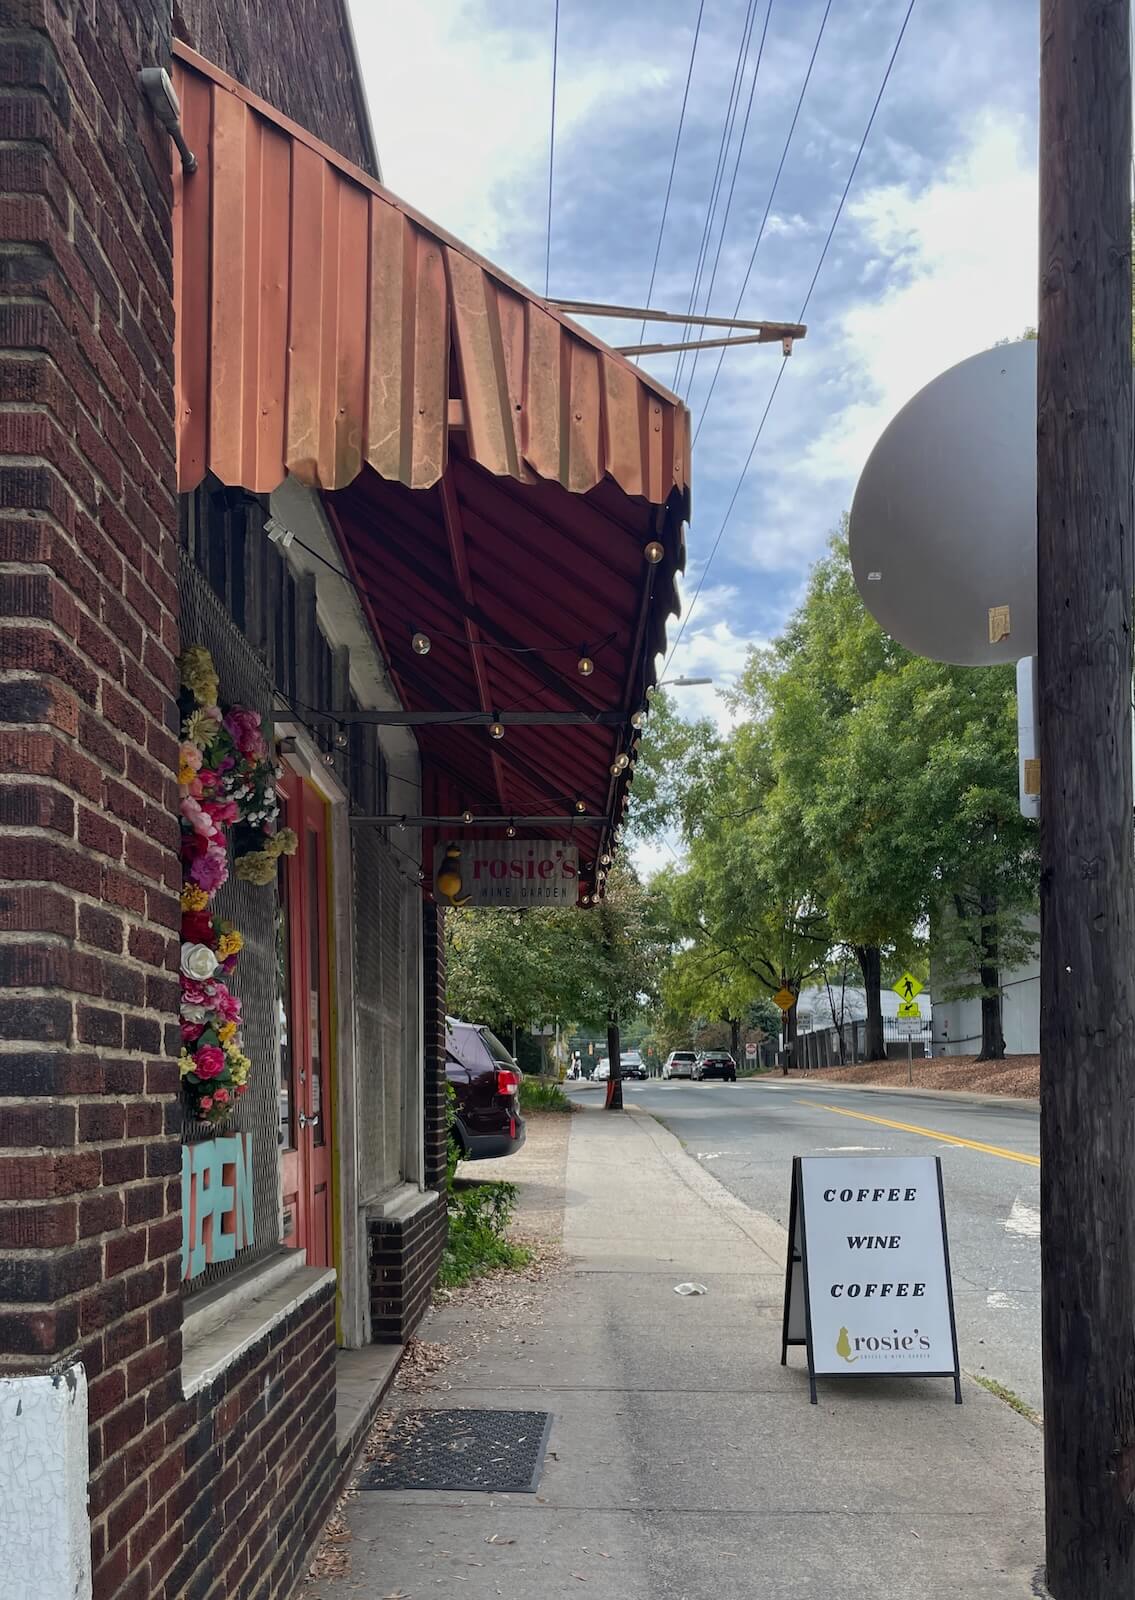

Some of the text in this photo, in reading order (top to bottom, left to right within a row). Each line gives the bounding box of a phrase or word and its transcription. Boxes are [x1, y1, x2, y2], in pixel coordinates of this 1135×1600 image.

[472, 850, 577, 880] rosie's
[481, 887, 511, 898] WINE
[823, 1187, 918, 1202] COFFEE
[846, 1235, 902, 1249] WINE
[830, 1283, 927, 1298] COFFEE
[854, 1328, 931, 1351] rosie's
